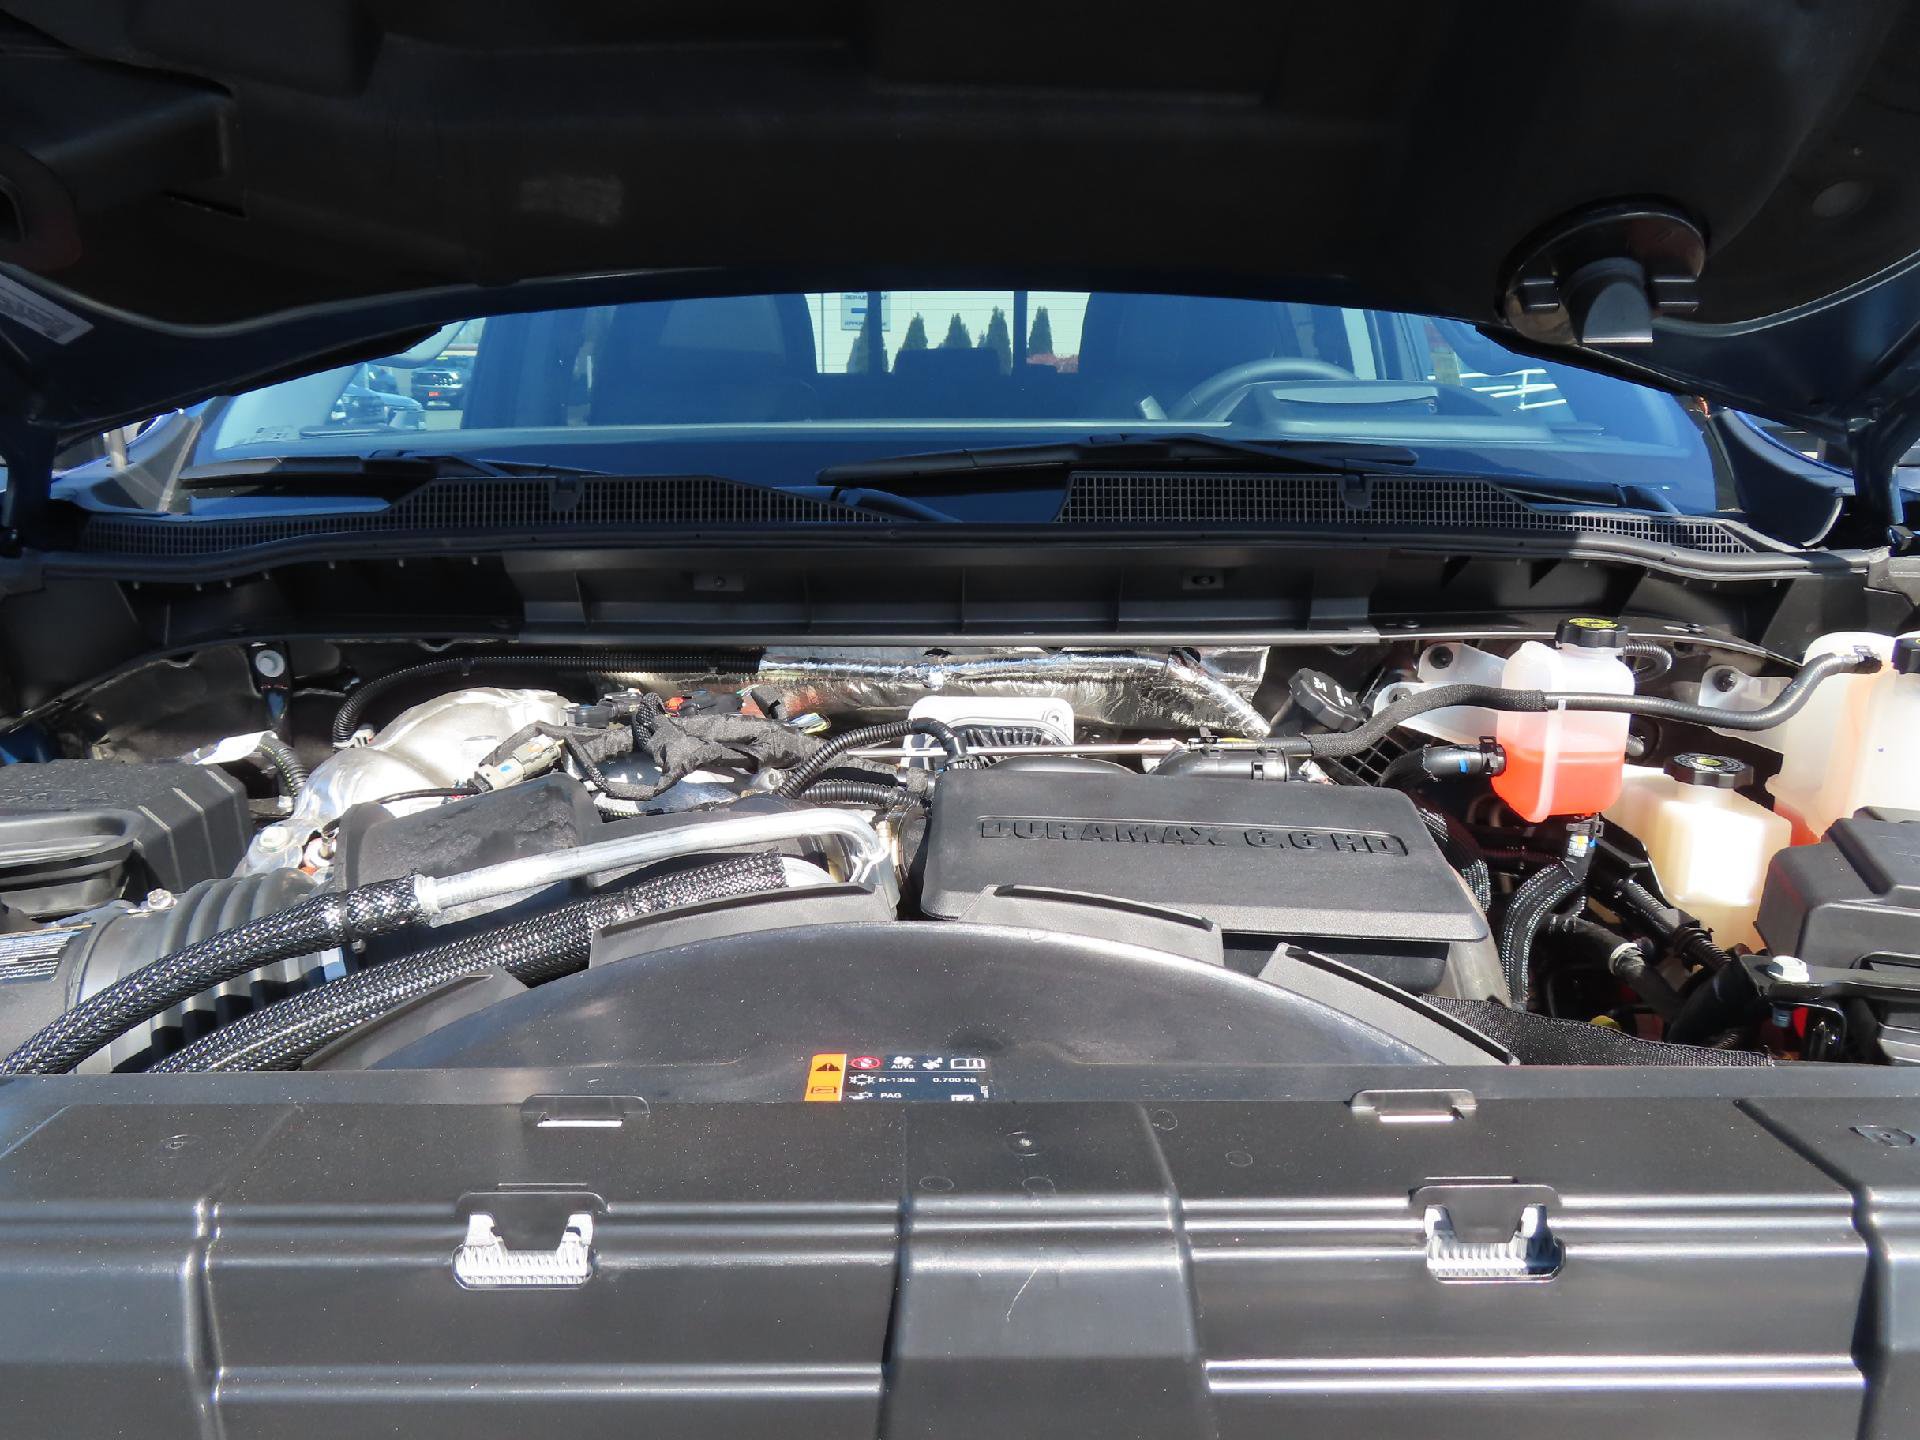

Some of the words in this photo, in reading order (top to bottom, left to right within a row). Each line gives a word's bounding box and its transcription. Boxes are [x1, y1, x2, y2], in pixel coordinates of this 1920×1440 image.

[980, 821, 1226, 846] DURAMAX
[1244, 829, 1322, 850] 6.6
[1330, 832, 1404, 856] HD
